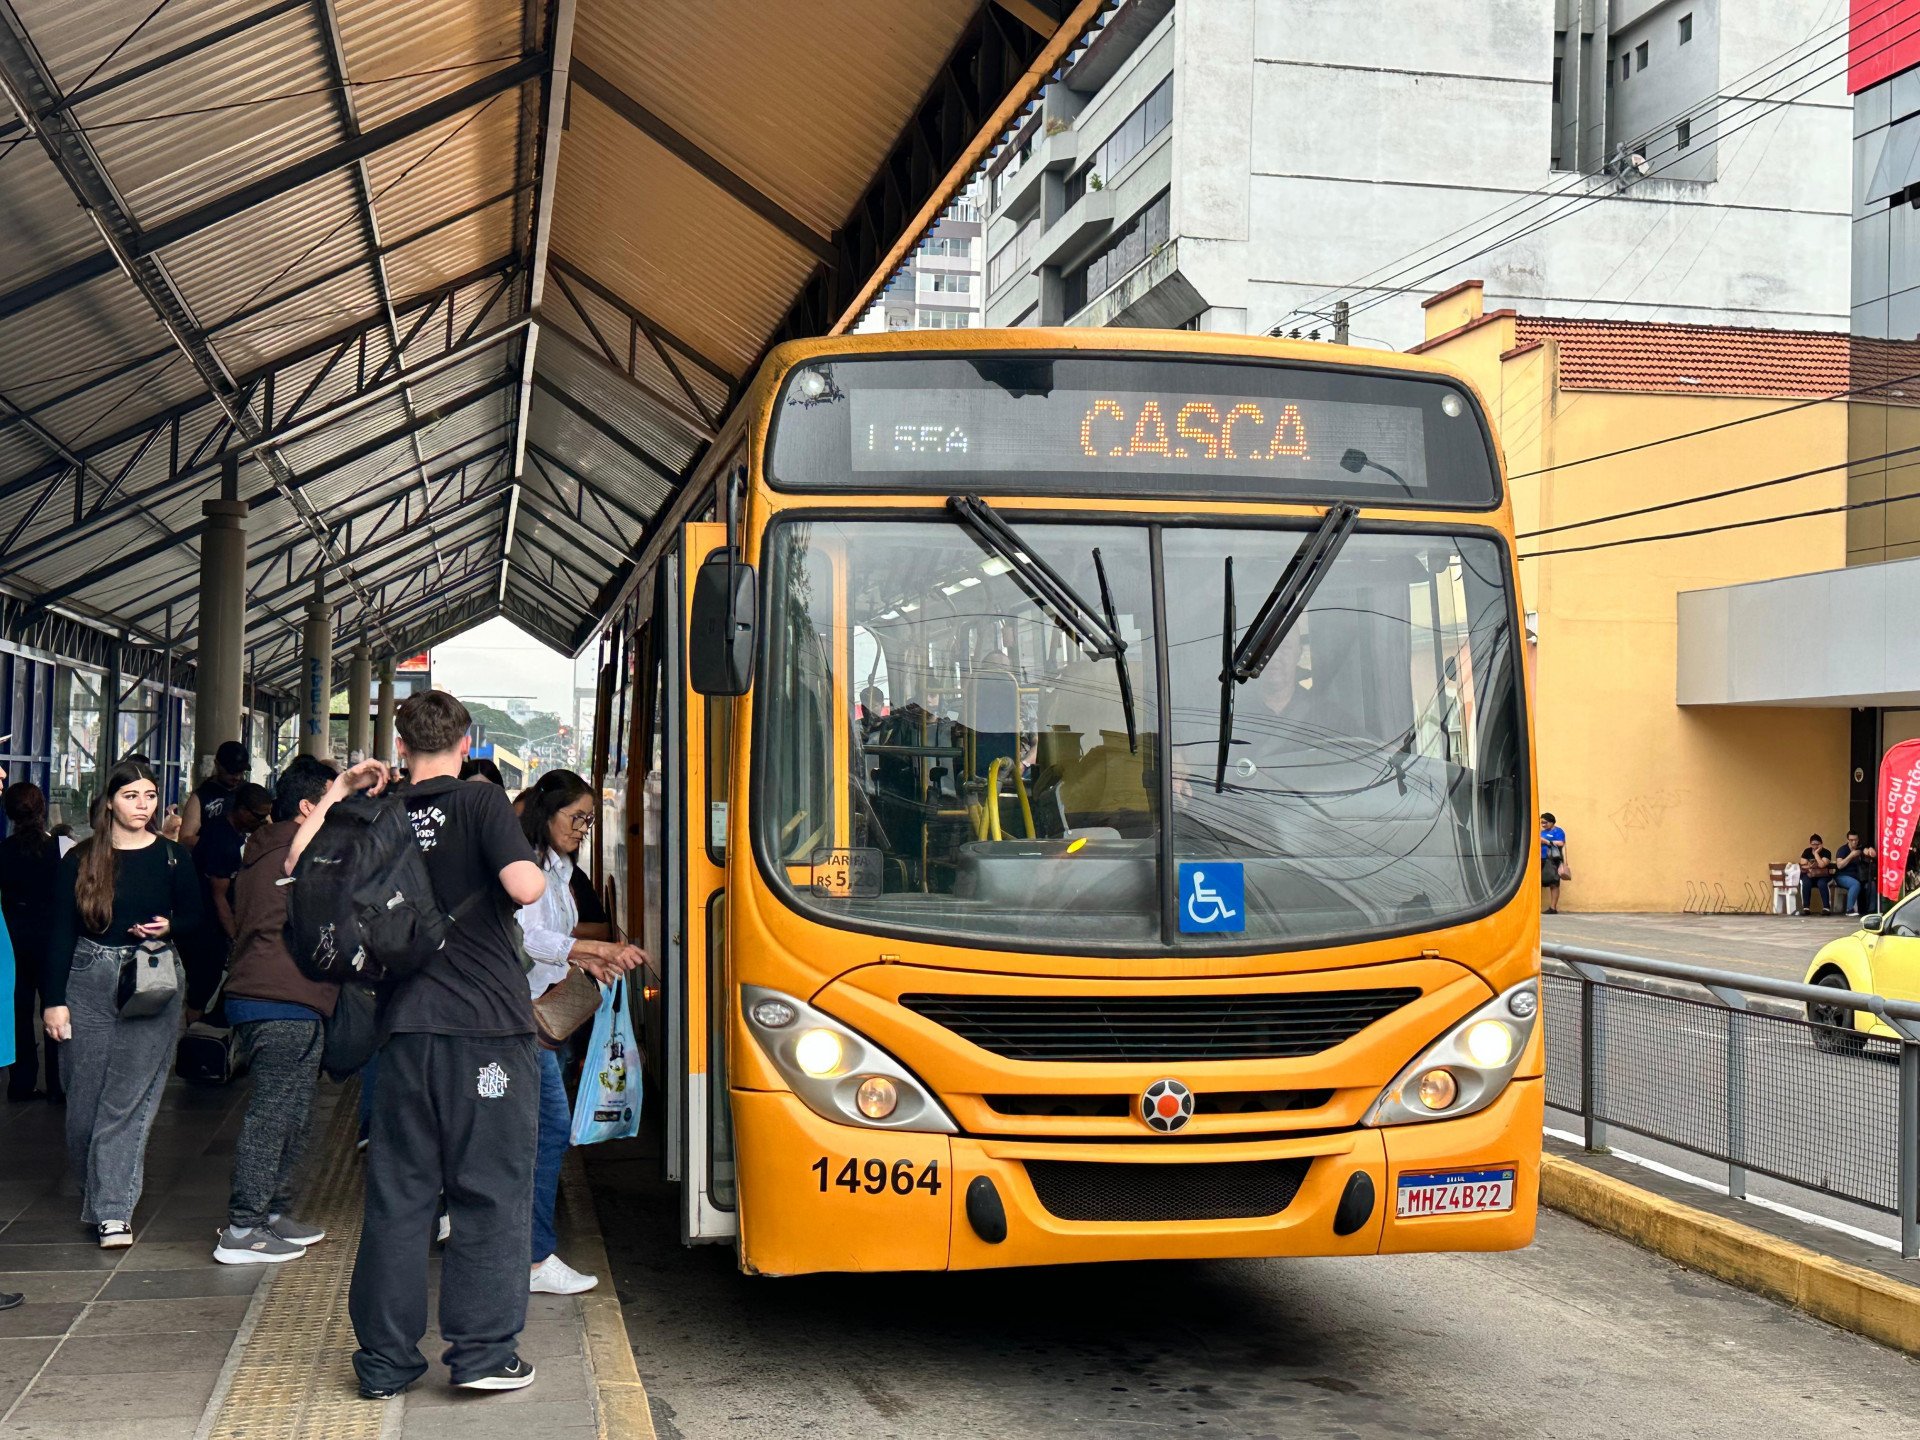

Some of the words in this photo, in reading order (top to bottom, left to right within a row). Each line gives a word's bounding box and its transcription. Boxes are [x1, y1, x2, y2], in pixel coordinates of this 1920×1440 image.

[1081, 400, 1310, 460] CASCA
[1893, 817, 1909, 847] seu
[826, 855, 868, 866] TARIFA
[1889, 850, 1901, 861] o
[816, 875, 832, 888] R$
[812, 1156, 942, 1195] 14964
[1408, 1184, 1501, 1212] MHZ4B22
